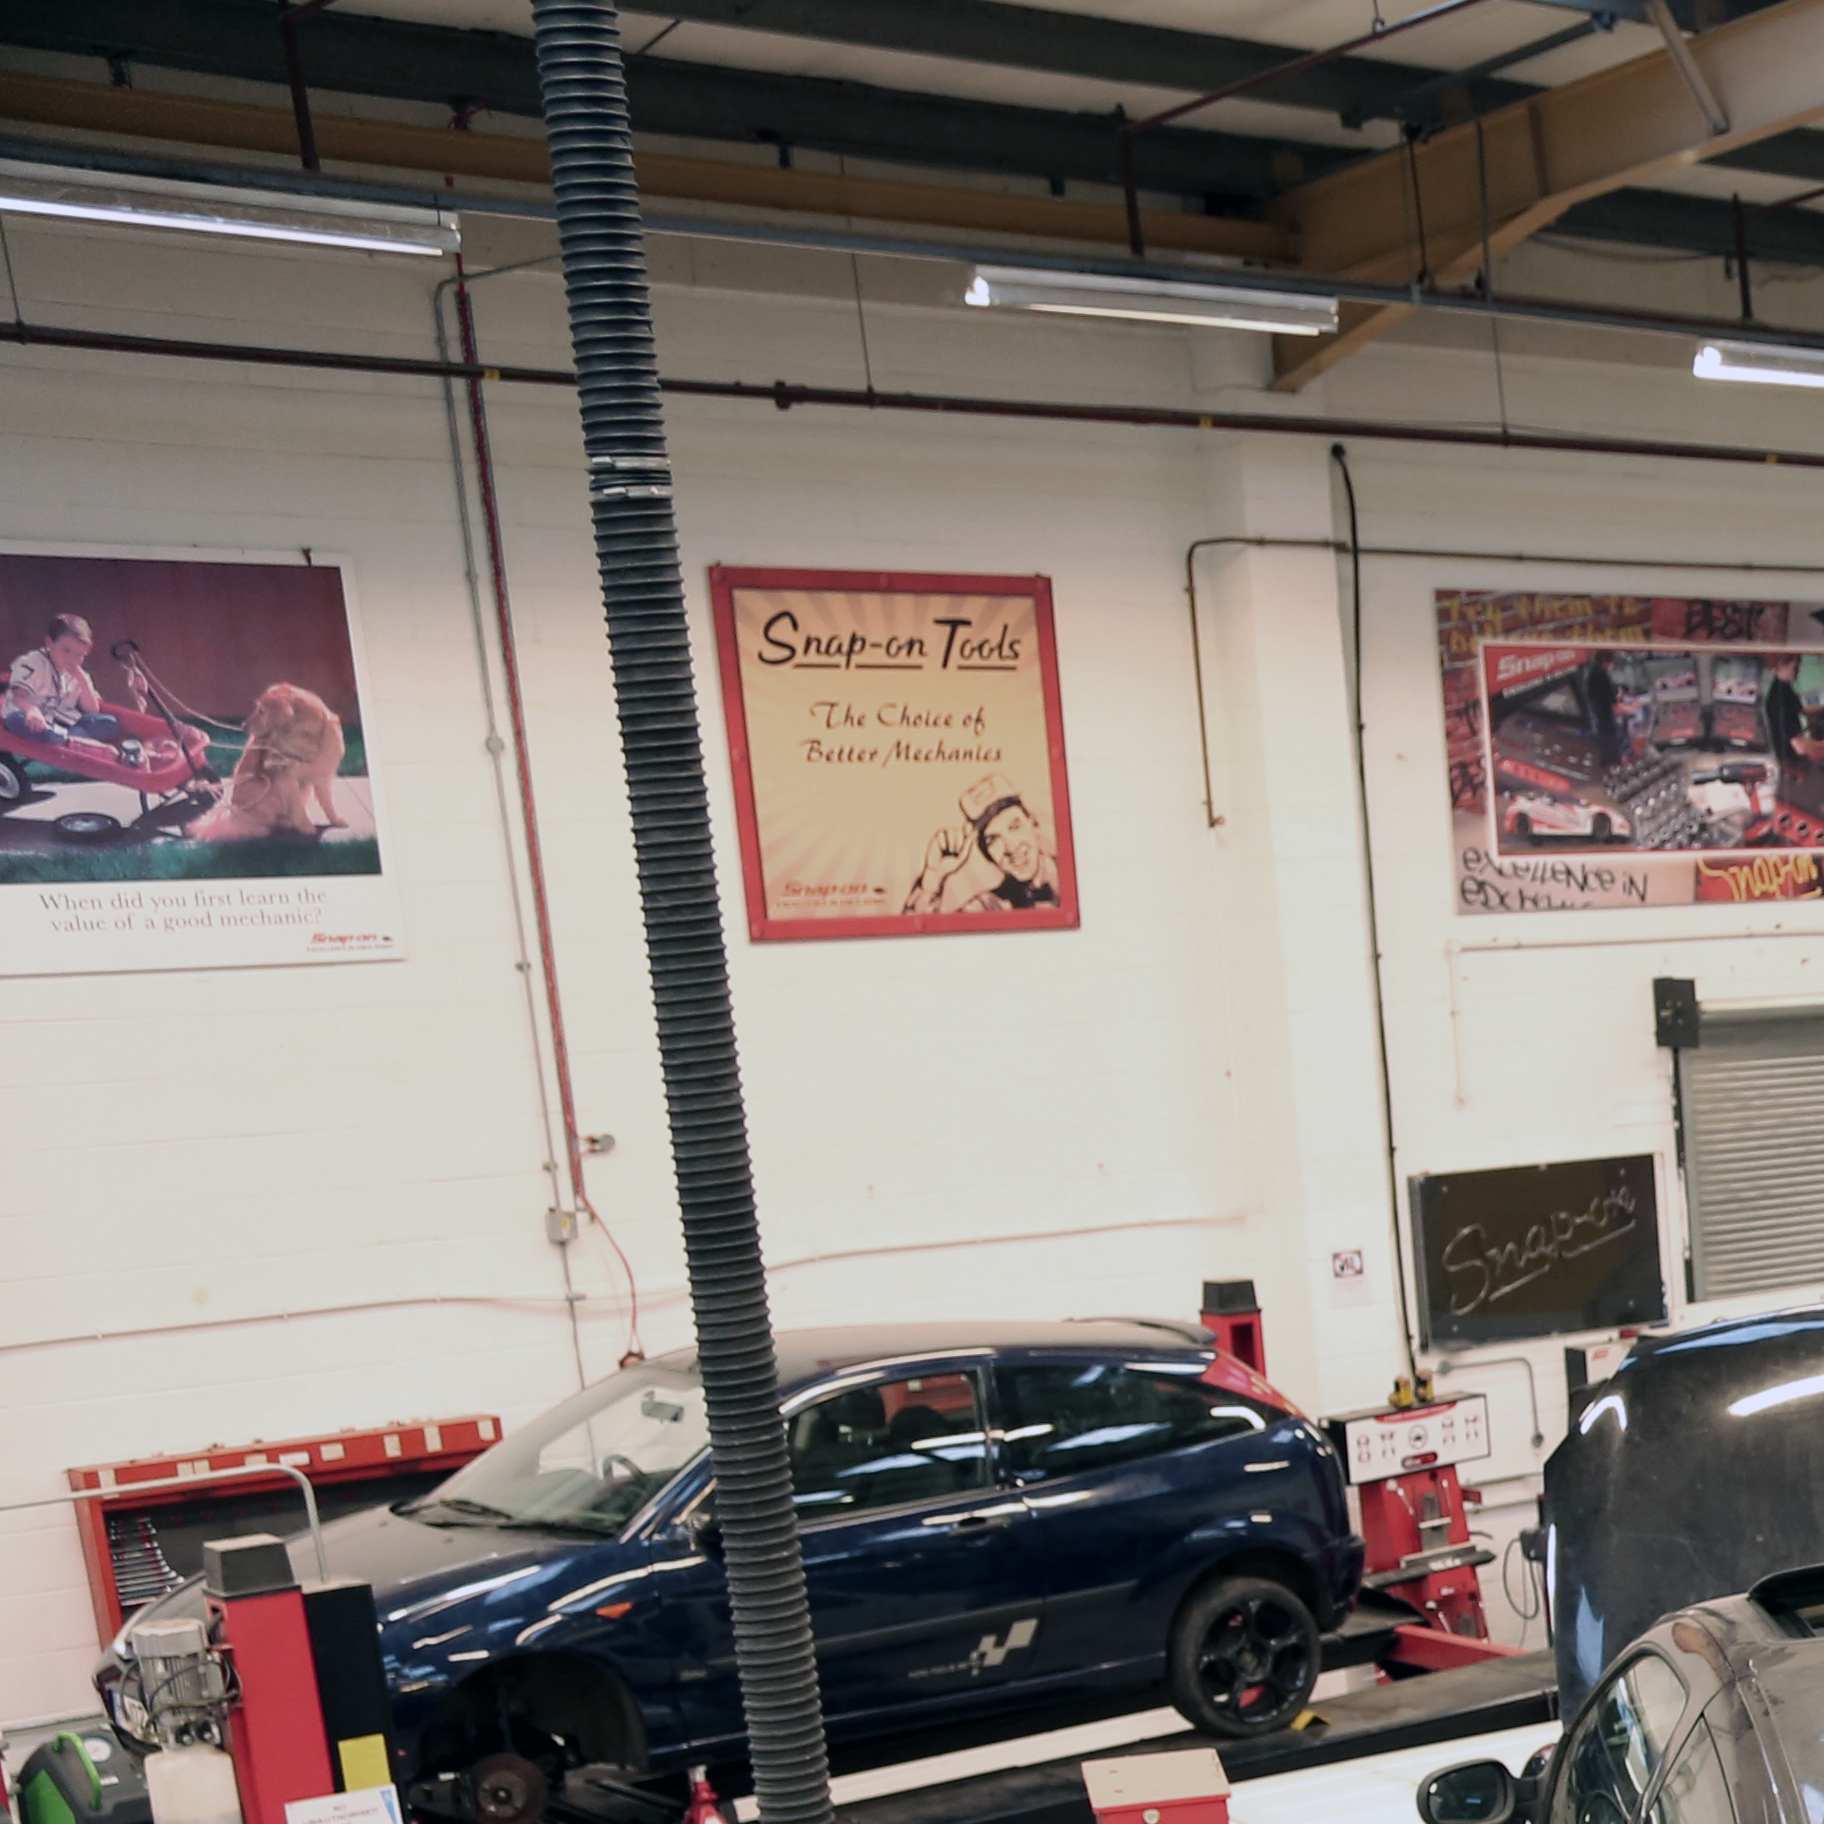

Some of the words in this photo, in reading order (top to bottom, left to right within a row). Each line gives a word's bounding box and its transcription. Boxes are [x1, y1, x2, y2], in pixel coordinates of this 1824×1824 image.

[758, 610, 927, 670] Snap-on
[932, 617, 1022, 671] Tools
[809, 701, 866, 730] The
[876, 702, 954, 729] Choice
[962, 704, 986, 737] of
[799, 738, 878, 764] Better
[880, 738, 1002, 768] Mechanics
[39, 893, 102, 912] When
[110, 891, 145, 910] did
[150, 894, 187, 914] you
[194, 889, 233, 908] first
[240, 889, 292, 907] learn
[298, 888, 328, 906] the
[50, 915, 107, 933] value
[114, 914, 136, 931] of
[144, 917, 156, 931] a
[164, 912, 213, 934] good
[220, 908, 323, 929] mechanic?
[1443, 1184, 1637, 1317] Snap-on
